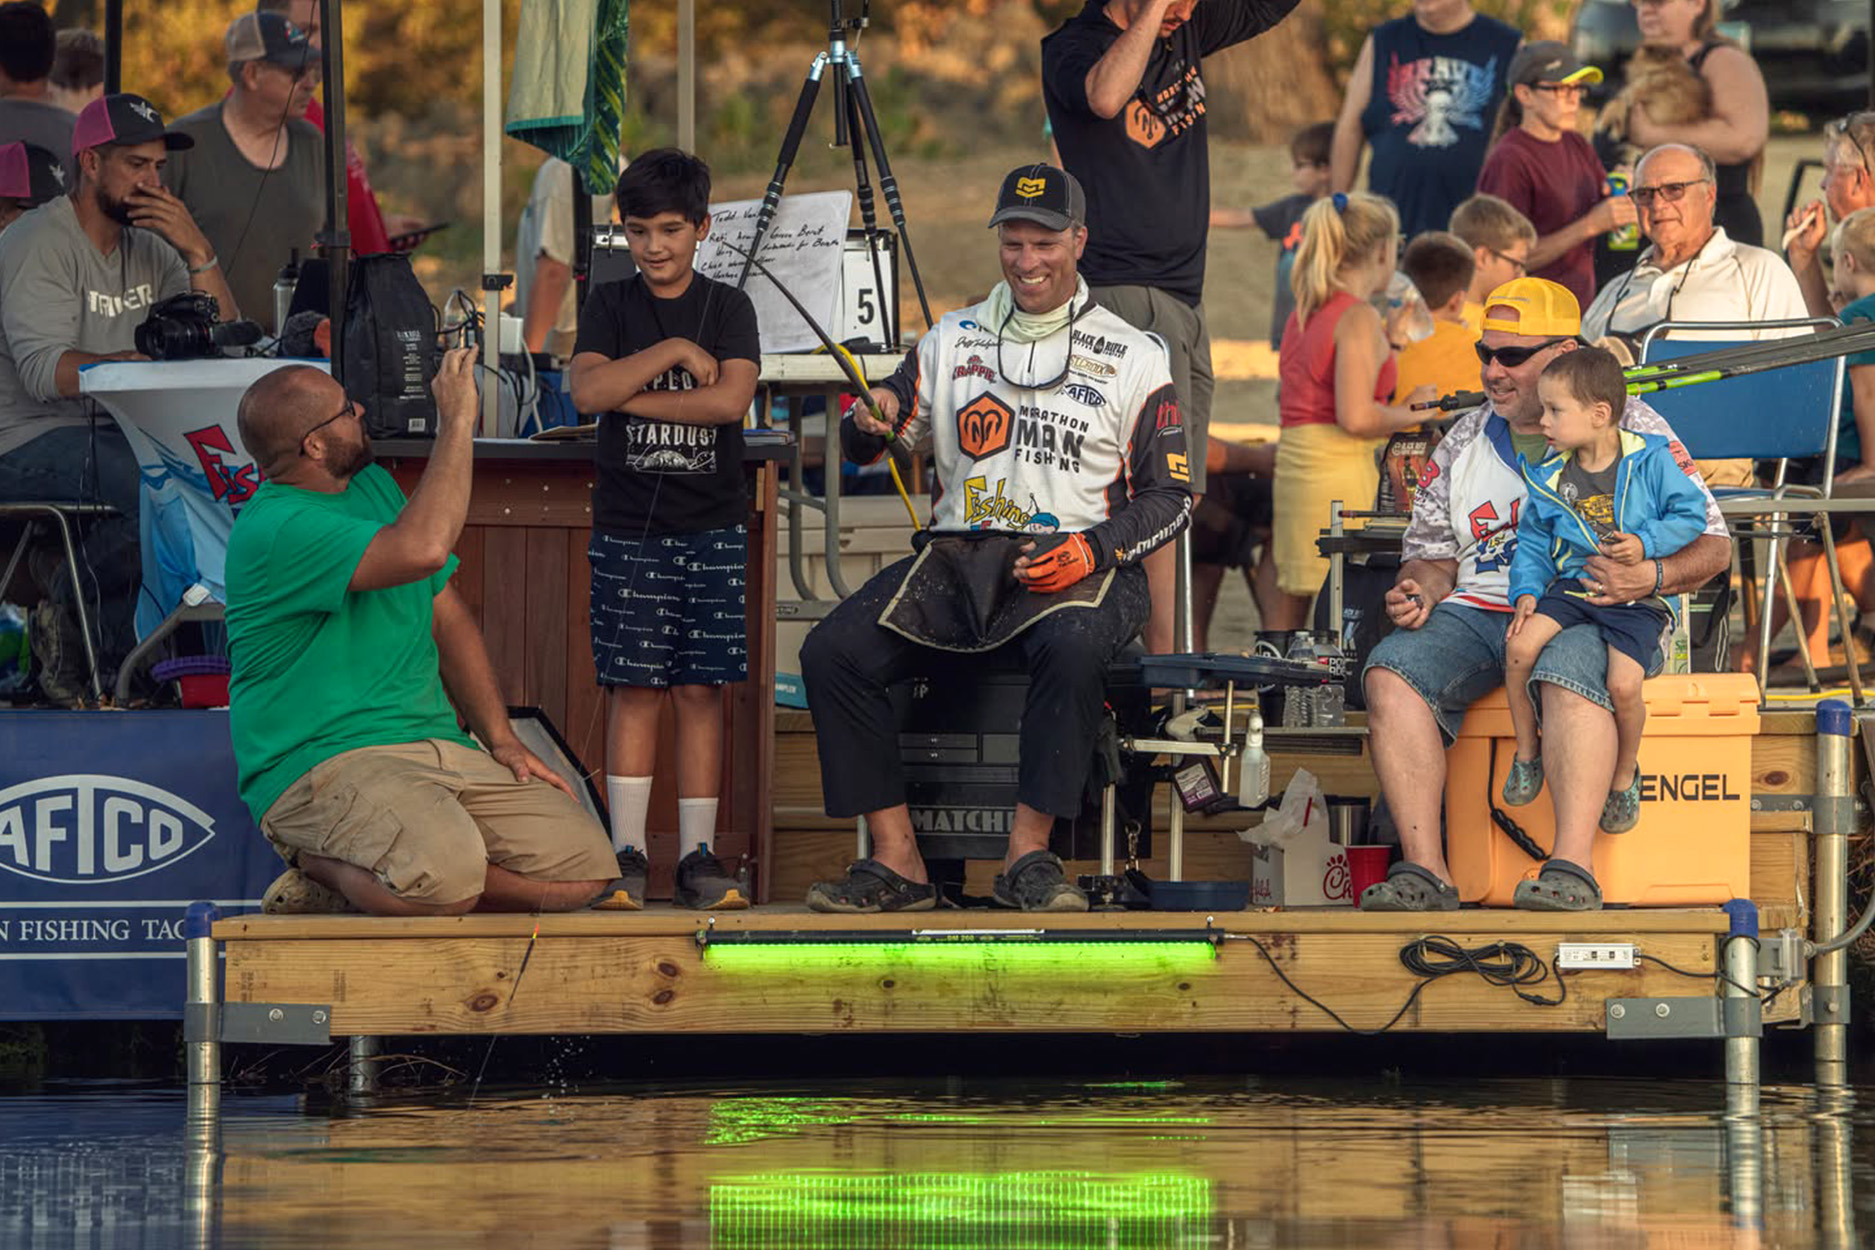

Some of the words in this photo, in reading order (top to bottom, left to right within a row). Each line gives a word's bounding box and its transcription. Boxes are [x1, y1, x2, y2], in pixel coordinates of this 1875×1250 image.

[858, 288, 875, 325] 5
[1019, 405, 1090, 433] MARATHON
[1017, 419, 1085, 459] MAN
[1014, 448, 1080, 474] FISHNG
[618, 588, 681, 602] Champion
[1639, 774, 1740, 801] ENGEL
[0, 786, 183, 875] AFTCO
[19, 919, 131, 940] FISHING
